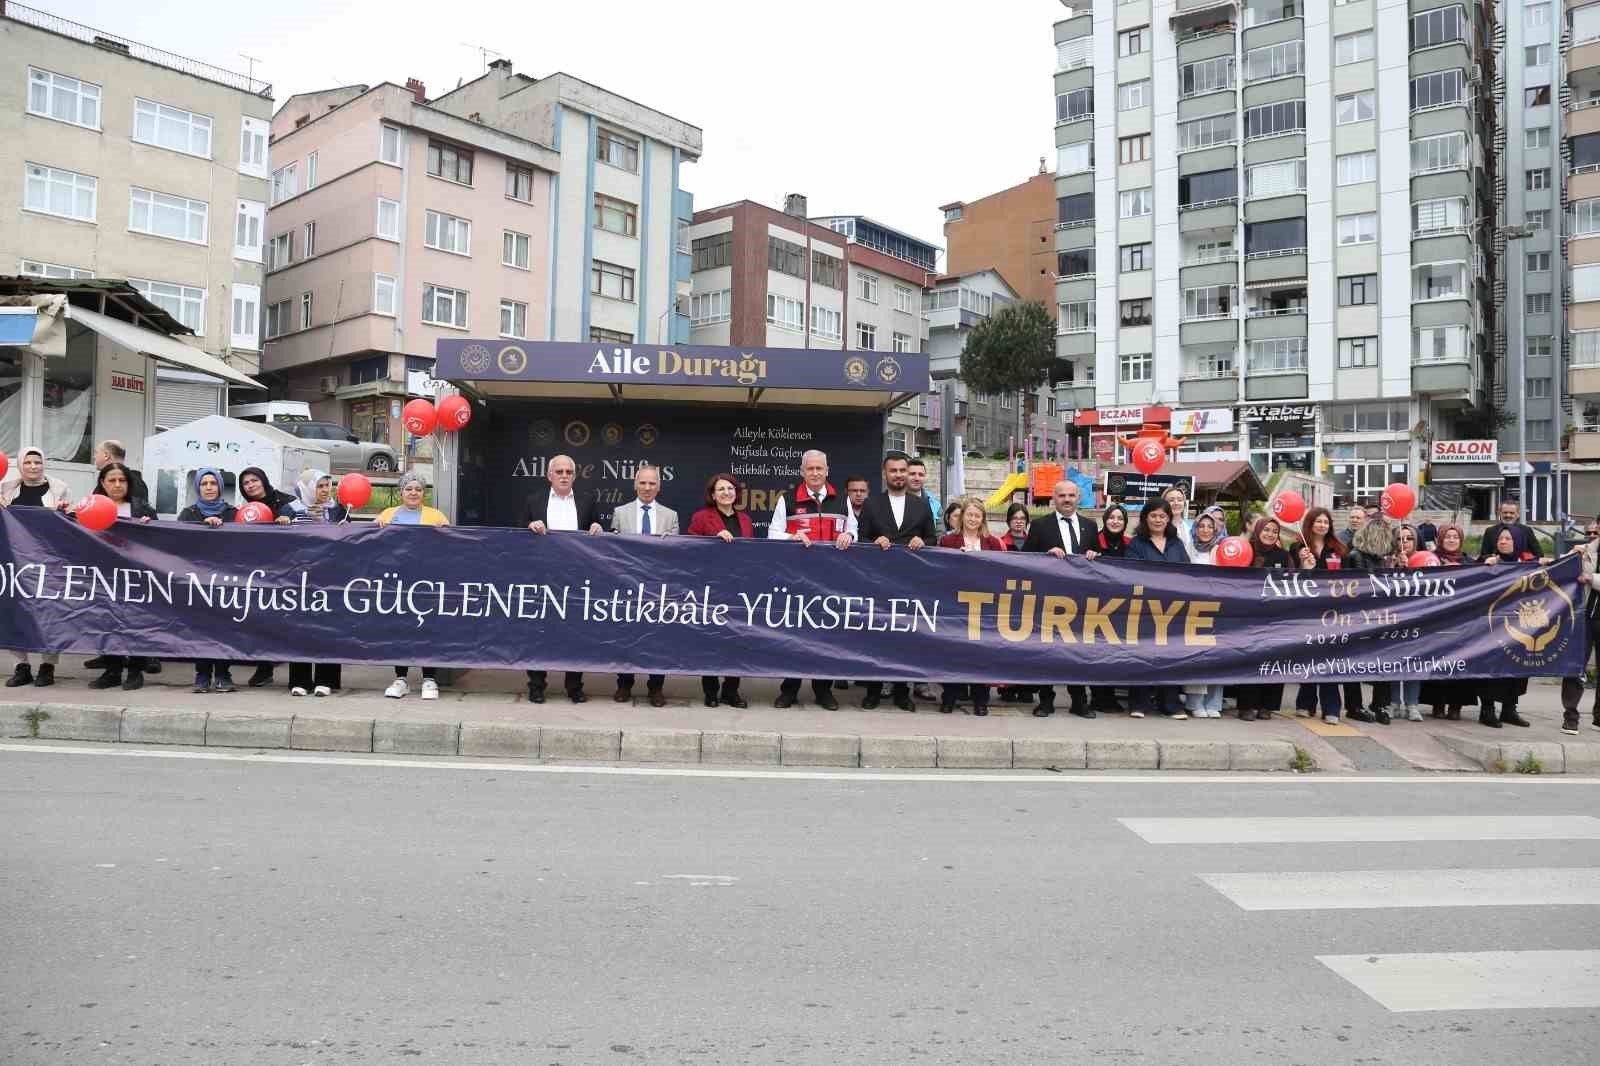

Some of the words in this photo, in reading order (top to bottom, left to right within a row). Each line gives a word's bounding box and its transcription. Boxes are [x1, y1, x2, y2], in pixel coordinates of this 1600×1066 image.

[588, 349, 650, 375] Aile
[657, 351, 767, 384] Durağı
[1100, 409, 1141, 419] ECZANE
[1246, 405, 1315, 419] Atabey
[734, 427, 766, 441] Aileyle
[768, 428, 812, 440] Köklenen
[731, 445, 768, 460] Nüfusla
[770, 447, 803, 460] Güçlen
[1435, 443, 1493, 454] SALON
[511, 456, 547, 477] Ail
[773, 464, 801, 476] Yükse
[1261, 573, 1320, 598] Aile
[1327, 577, 1361, 598] ve
[1369, 571, 1457, 598] Nüfus
[186, 569, 333, 623] Nüfusla
[343, 572, 569, 628] GÜÇLENEN
[581, 579, 729, 626] İstikbâle
[737, 586, 940, 633] YÜKSELEN
[957, 579, 1221, 646] TÜRKİYE
[1321, 609, 1351, 627] On
[1361, 608, 1400, 625] Yılı
[1304, 633, 1350, 645] 2026
[1258, 656, 1467, 678] #AileyleYükselenTürkiye
